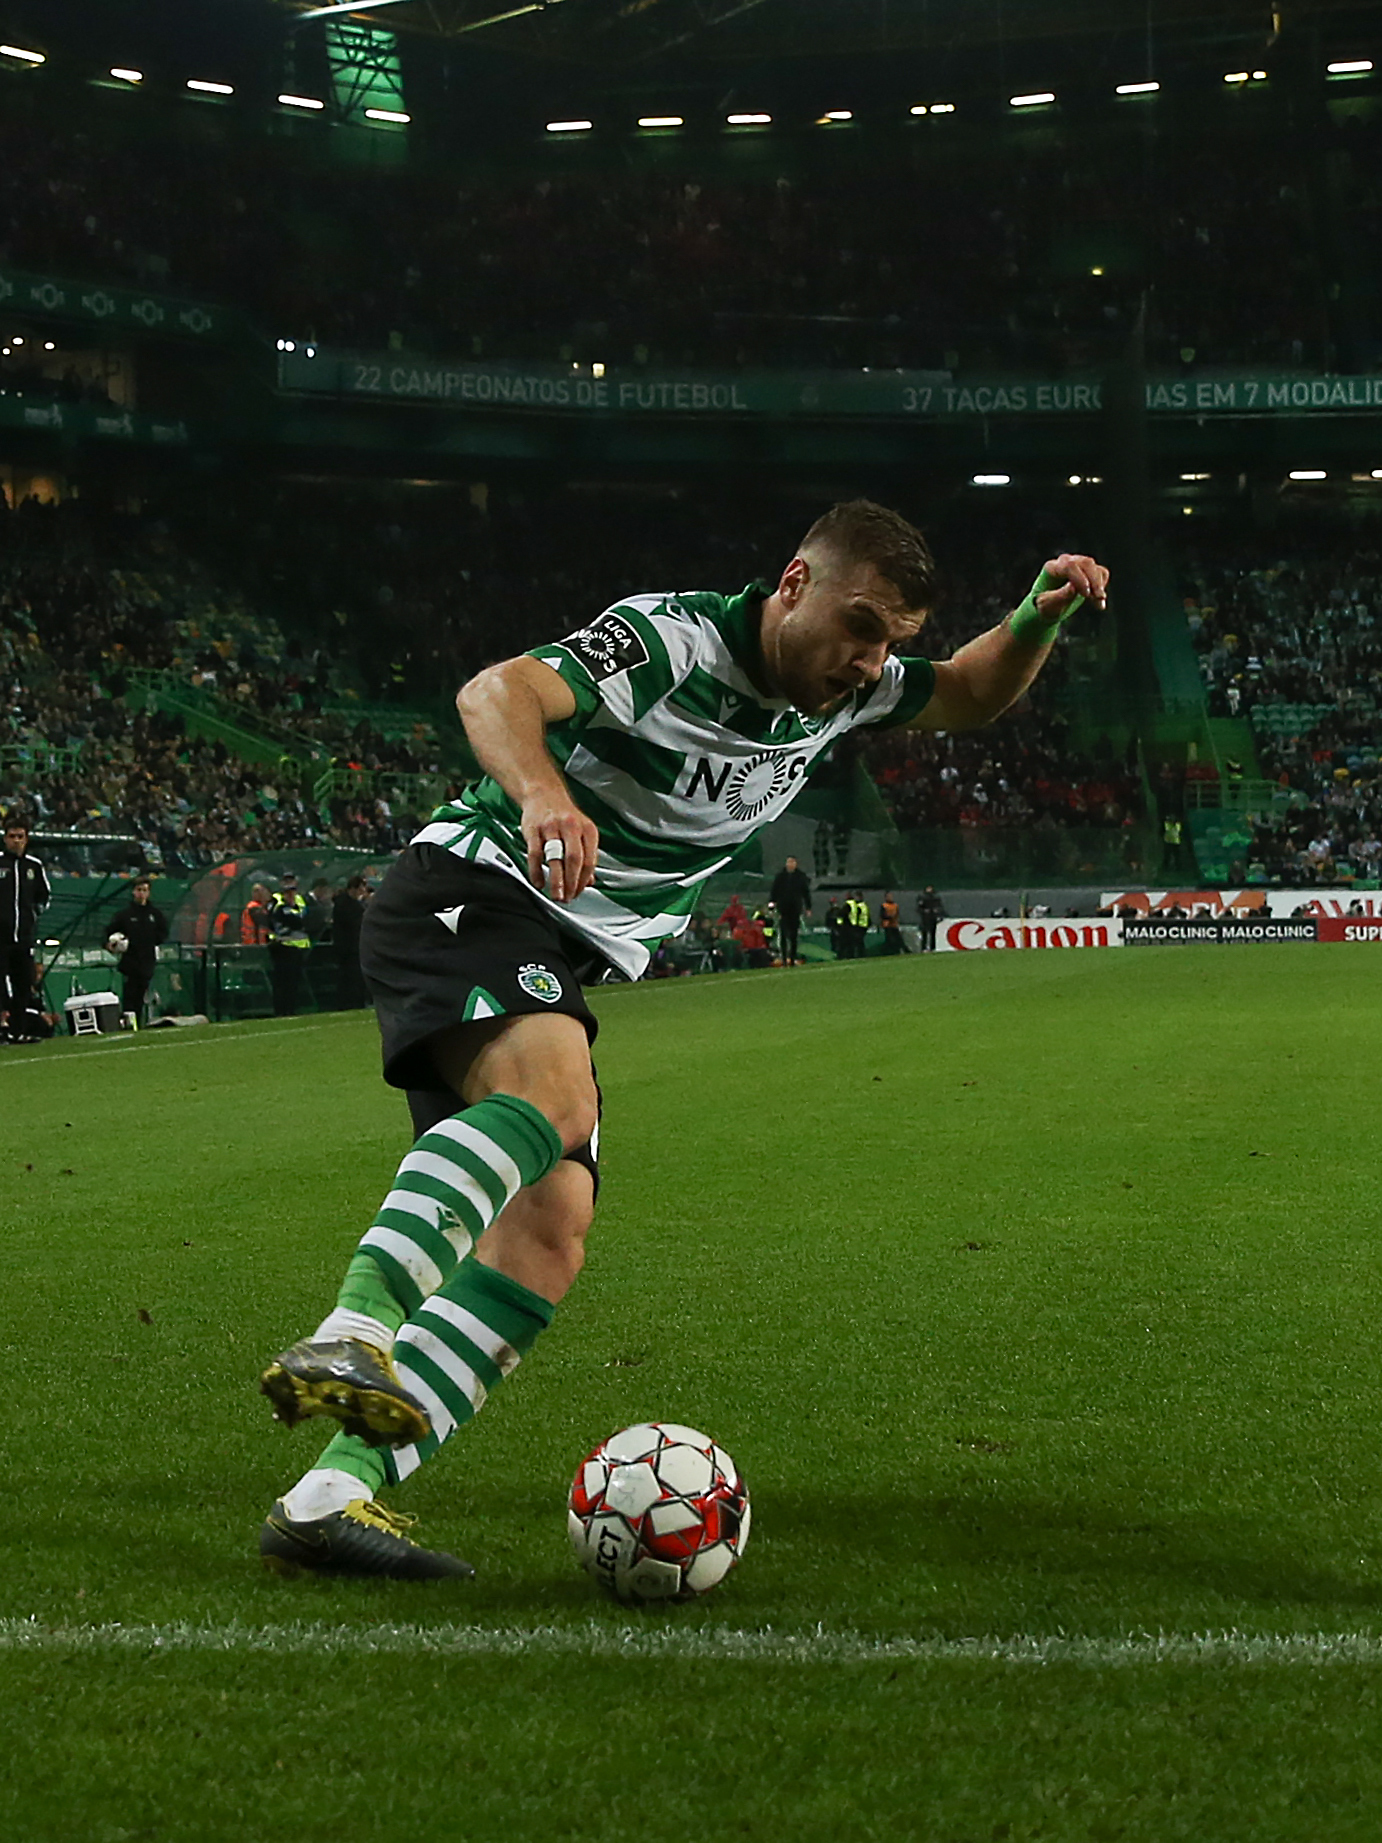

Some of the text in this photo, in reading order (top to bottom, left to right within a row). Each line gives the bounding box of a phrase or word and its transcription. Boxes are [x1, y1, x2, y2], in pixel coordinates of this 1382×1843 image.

[354, 365, 748, 409] 22 CAMPEONATOS DE FUTEBOL
[902, 387, 932, 411] 37
[1197, 383, 1235, 408] EM
[1244, 383, 1259, 407] 7
[604, 620, 632, 649] LIGA
[946, 920, 1109, 951] Canon
